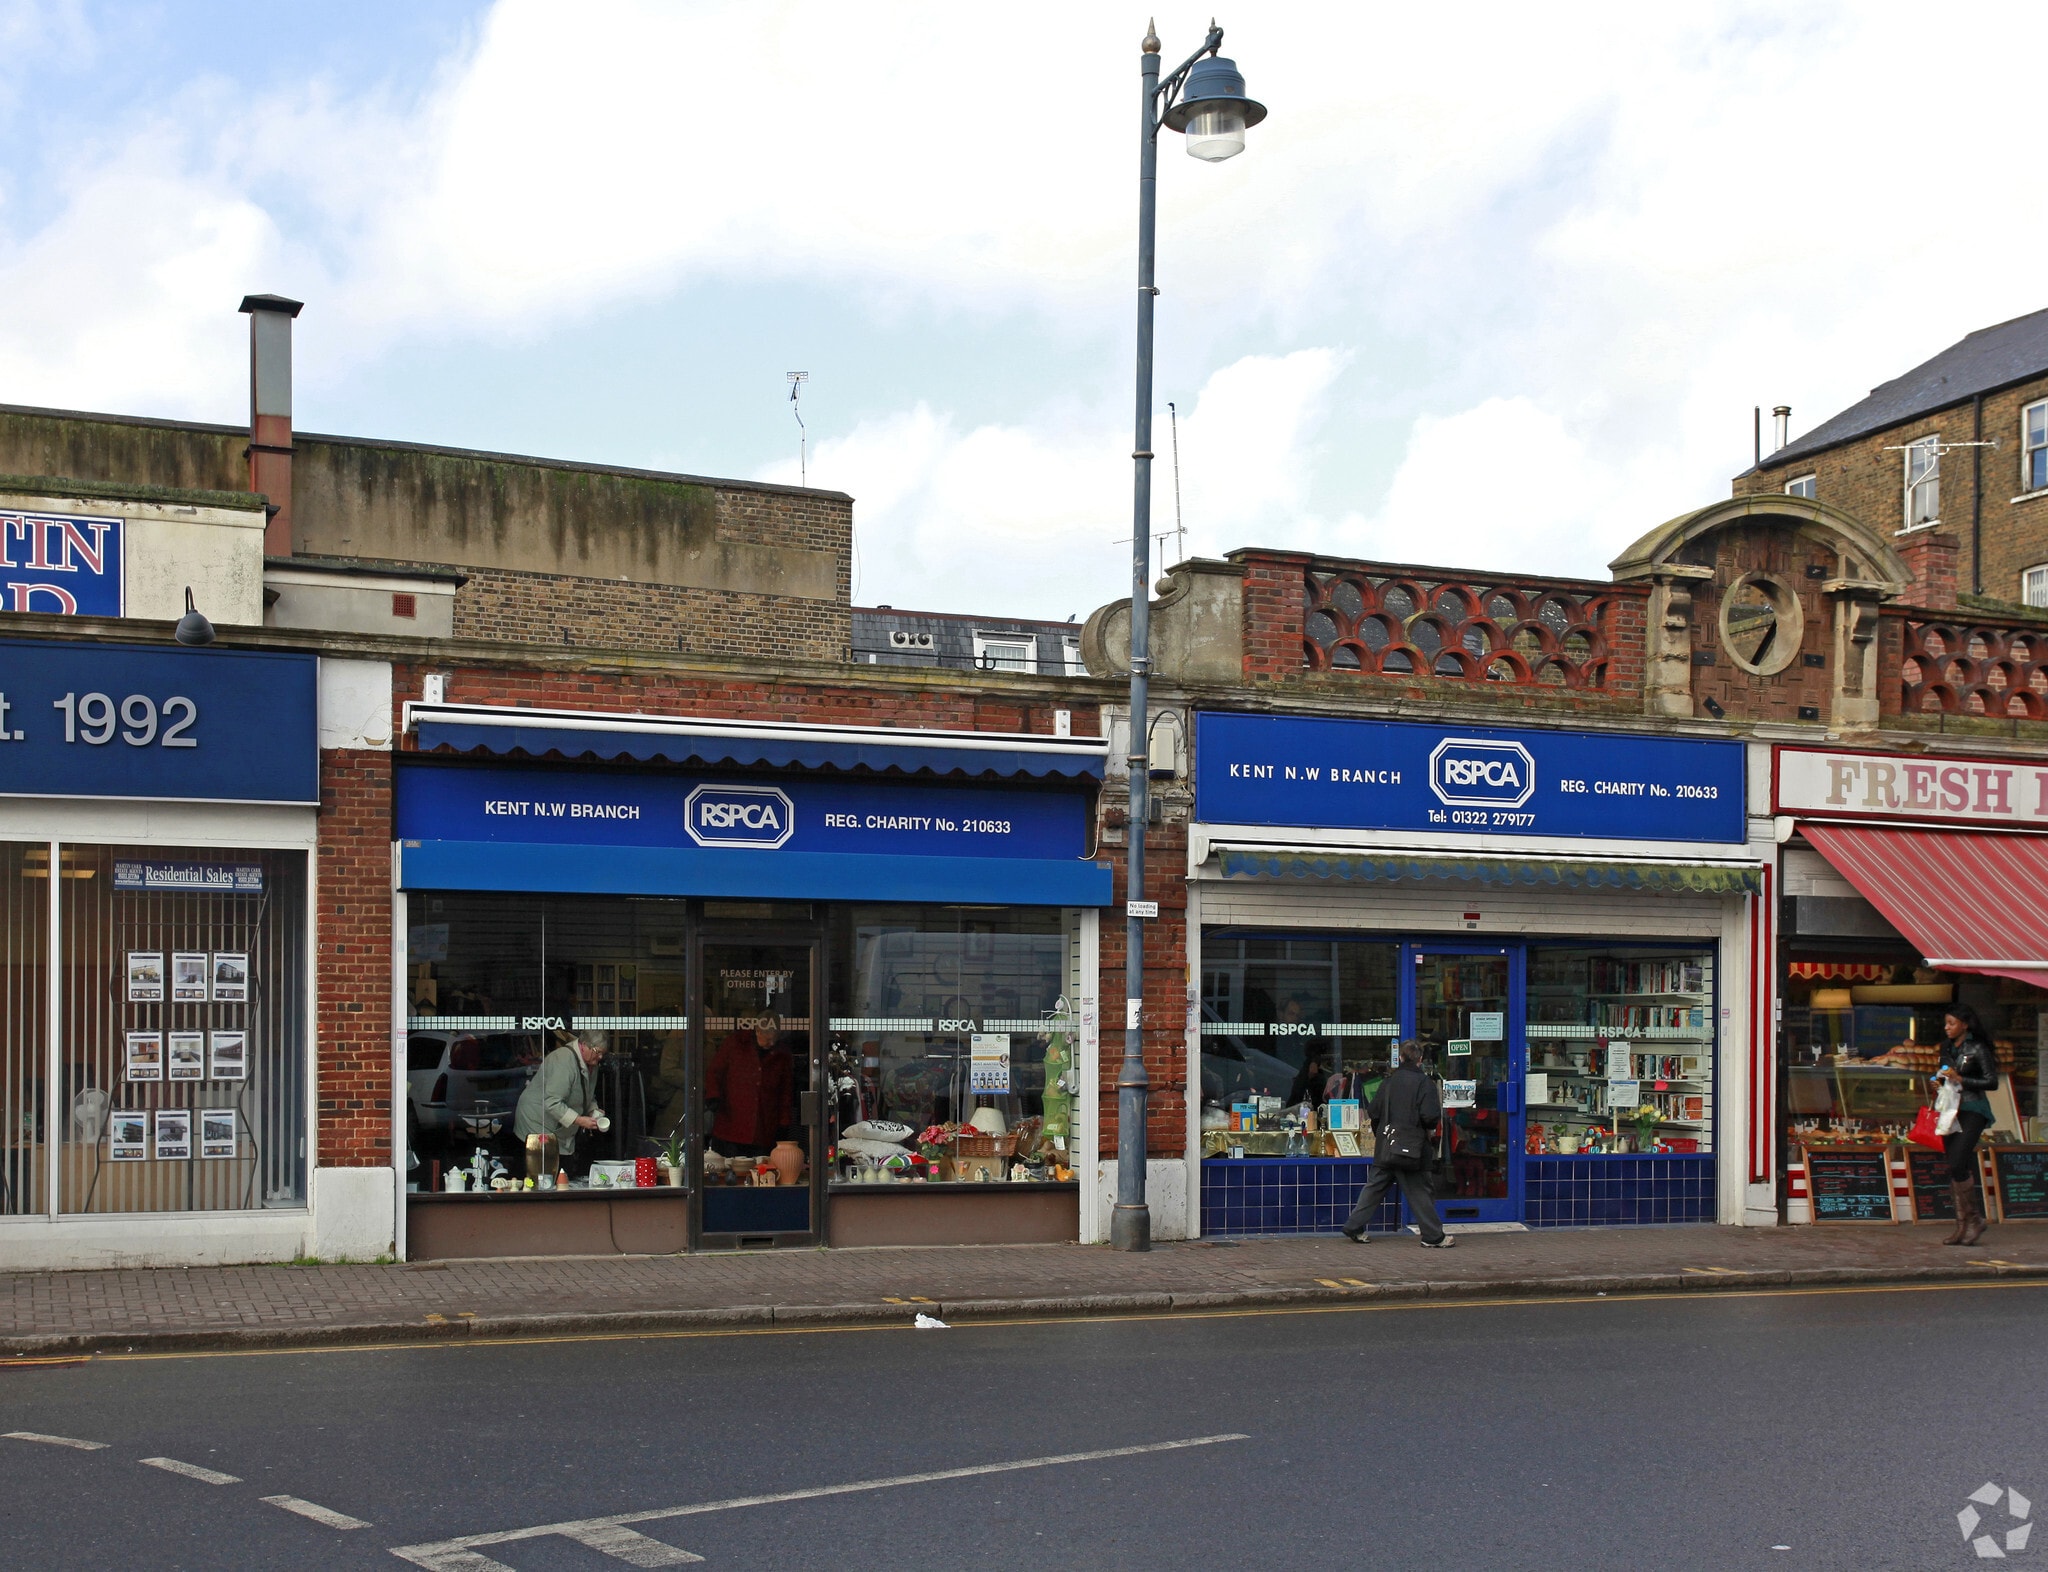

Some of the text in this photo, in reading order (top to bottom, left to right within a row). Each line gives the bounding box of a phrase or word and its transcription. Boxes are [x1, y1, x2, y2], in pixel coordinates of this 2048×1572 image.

[53, 692, 197, 747] 1992
[1230, 763, 1401, 785] KENT N.W BRANCH
[1445, 759, 1520, 788] RSPCA
[1560, 779, 1718, 799] REG. CHARITY No. 210633
[1826, 759, 2013, 814] FRESH
[485, 800, 640, 820] KENT N.W BRANCH
[701, 802, 779, 830] RSPCA
[1428, 809, 1536, 827] Tel: 01322 279177
[825, 813, 1011, 834] REG. CHARITY No. 210633
[145, 865, 203, 882] Residential
[206, 867, 233, 883] Sales
[720, 969, 794, 979] PLEASE ENTER BY
[726, 980, 756, 989] OTHER
[522, 1016, 566, 1031] RSPCA
[736, 1017, 777, 1030] RSPCA
[938, 1019, 977, 1032] RSPCA
[1269, 1023, 1317, 1036] RSPCA
[1598, 1025, 1642, 1039] RSPCA
[1451, 1043, 1469, 1051] OPEN
